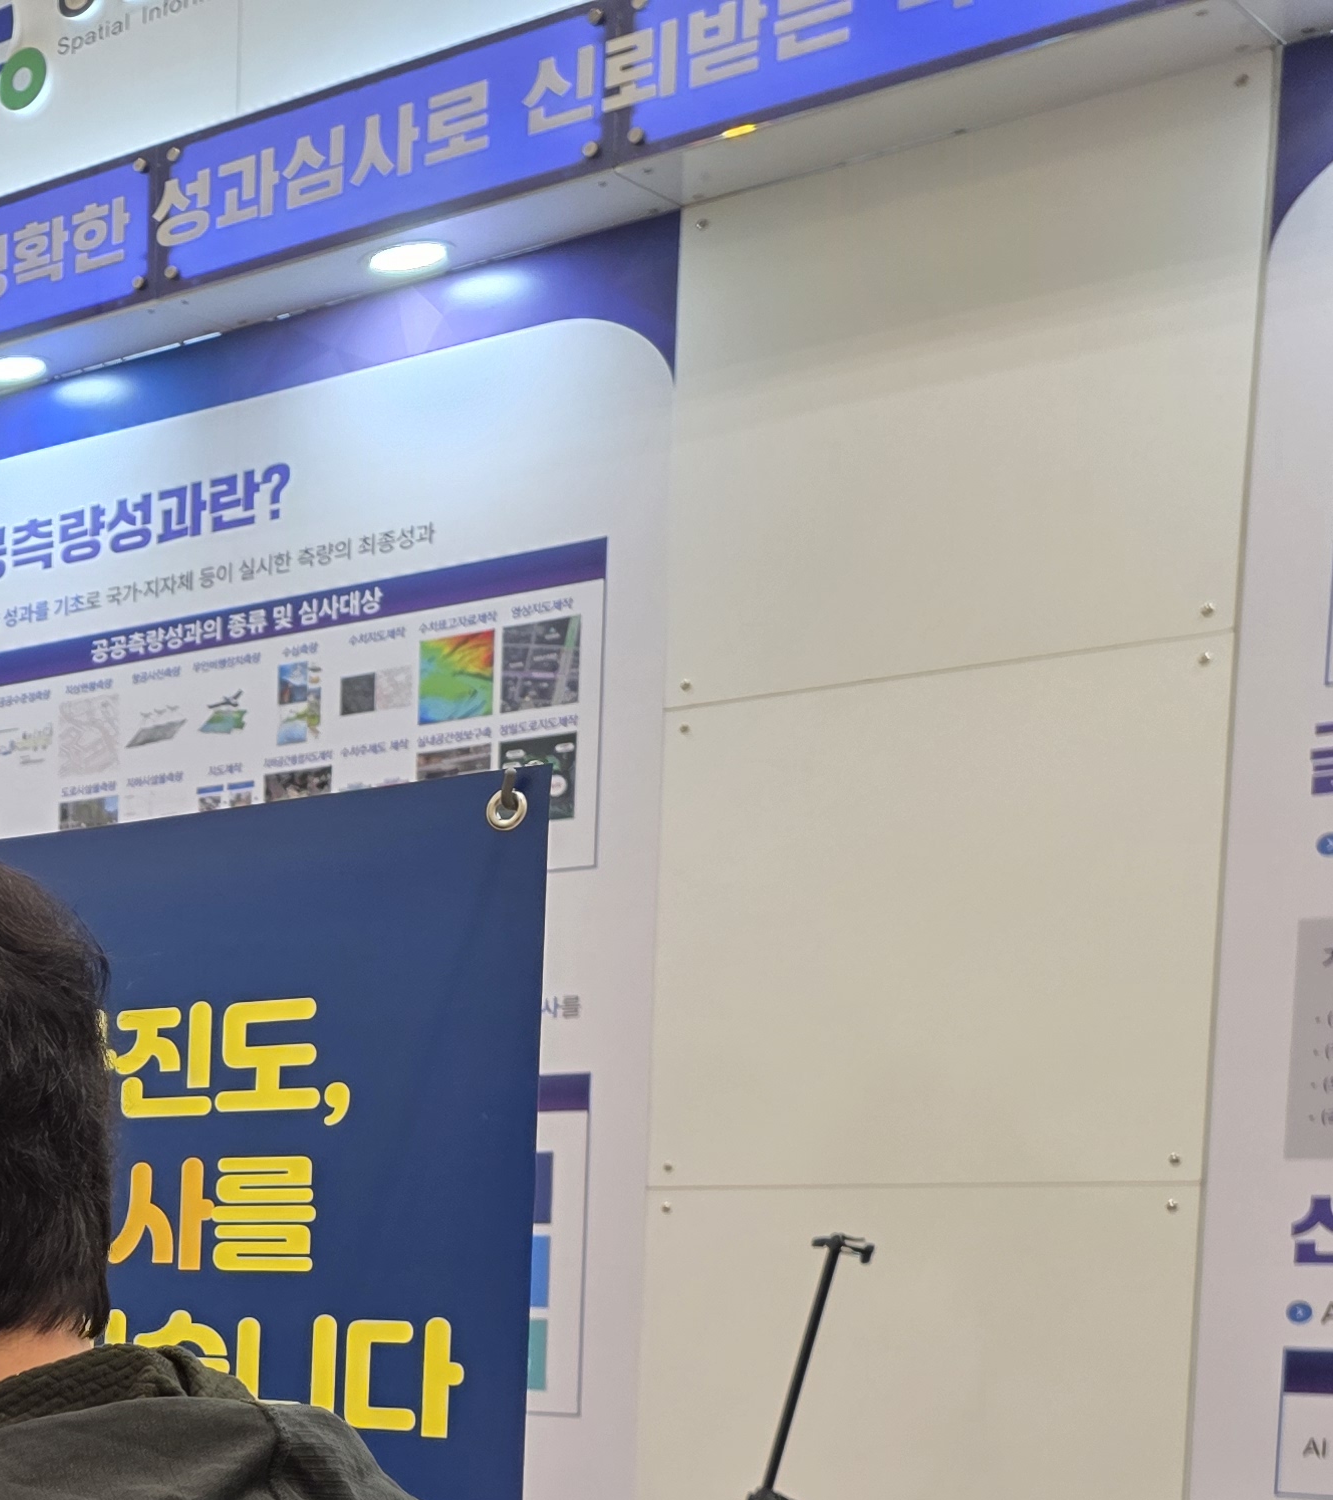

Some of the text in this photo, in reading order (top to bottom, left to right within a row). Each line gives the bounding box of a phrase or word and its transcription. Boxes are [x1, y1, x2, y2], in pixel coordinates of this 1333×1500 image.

[57, 14, 131, 55] Spatial
[152, 80, 491, 248] 성과심사로
[3, 600, 49, 629] 성과를
[54, 590, 102, 617] 기초로
[199, 562, 233, 589] 등이
[239, 553, 292, 582] 실시한
[298, 538, 352, 567] 측량의
[358, 521, 436, 556] 최종성과
[91, 586, 384, 664] 공공측량성과의 종류 및 심사대상
[99, 997, 352, 1127] 진도,
[1303, 1437, 1327, 1459] AI
